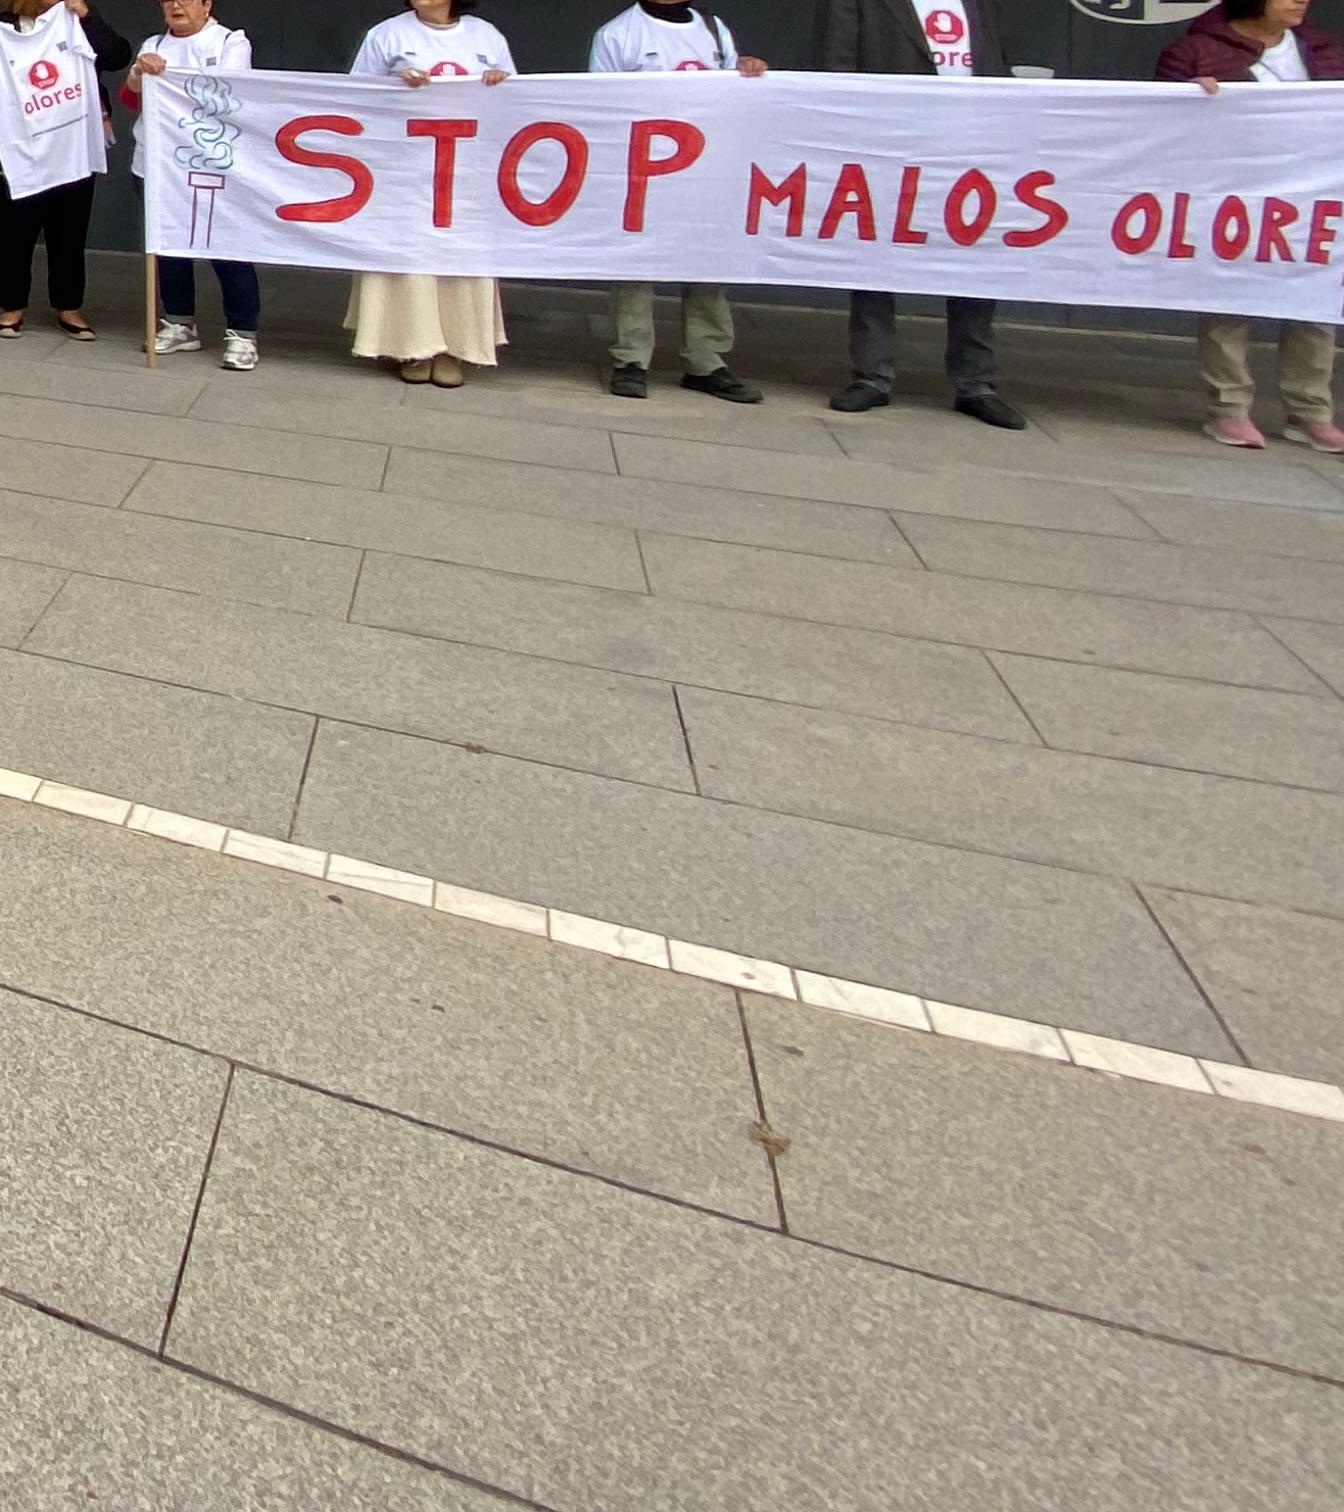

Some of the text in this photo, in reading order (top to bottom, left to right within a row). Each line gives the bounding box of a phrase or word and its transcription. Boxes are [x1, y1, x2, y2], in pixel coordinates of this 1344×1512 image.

[274, 114, 1343, 265] STOP MALOS OLORE
